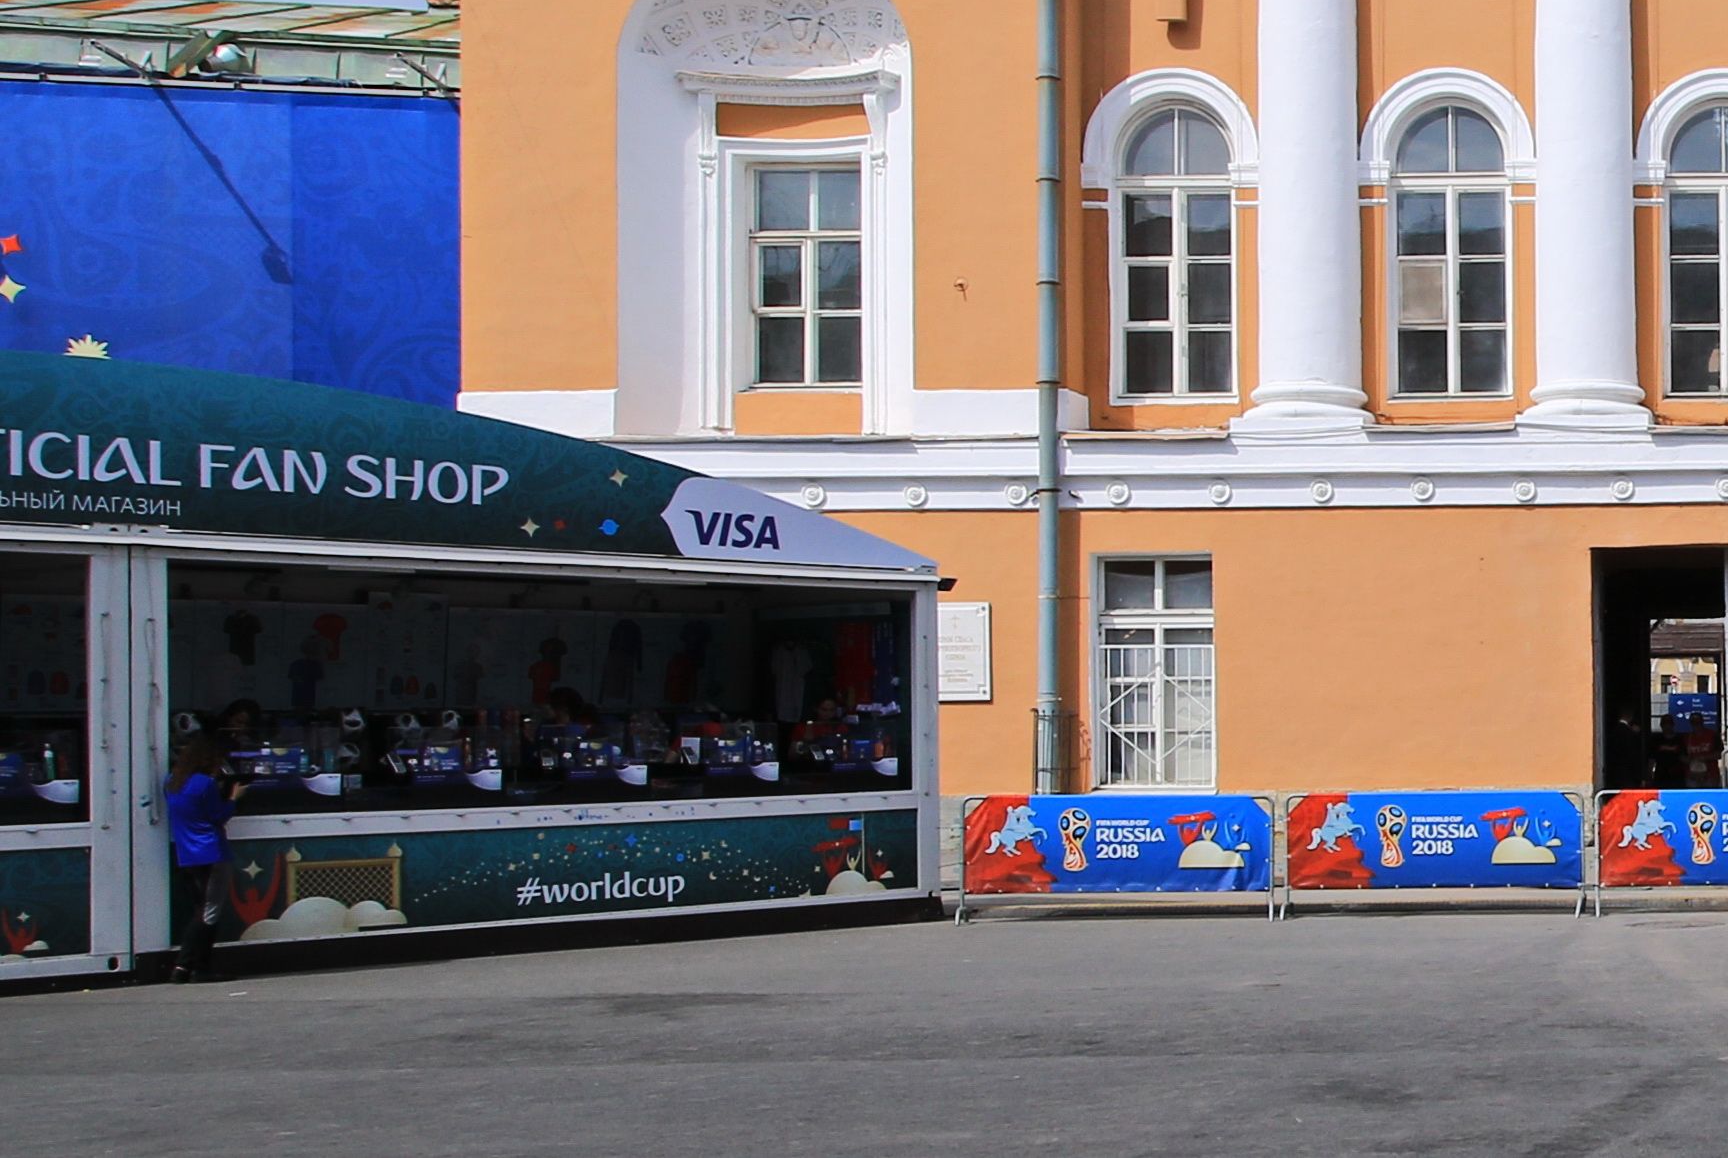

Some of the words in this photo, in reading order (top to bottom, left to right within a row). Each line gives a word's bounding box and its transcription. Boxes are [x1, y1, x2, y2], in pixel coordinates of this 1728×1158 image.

[0, 429, 182, 487] ICIAL
[200, 443, 328, 495] FAN
[344, 453, 510, 506] SHOP
[72, 494, 182, 517] МАГАЗИН
[684, 509, 780, 550] VISA
[1096, 827, 1165, 842] RUSSIA
[1411, 824, 1479, 839] RUSSIA
[1096, 843, 1139, 859] 2018
[1412, 840, 1454, 855] 2018
[516, 871, 686, 906] #worldcup
